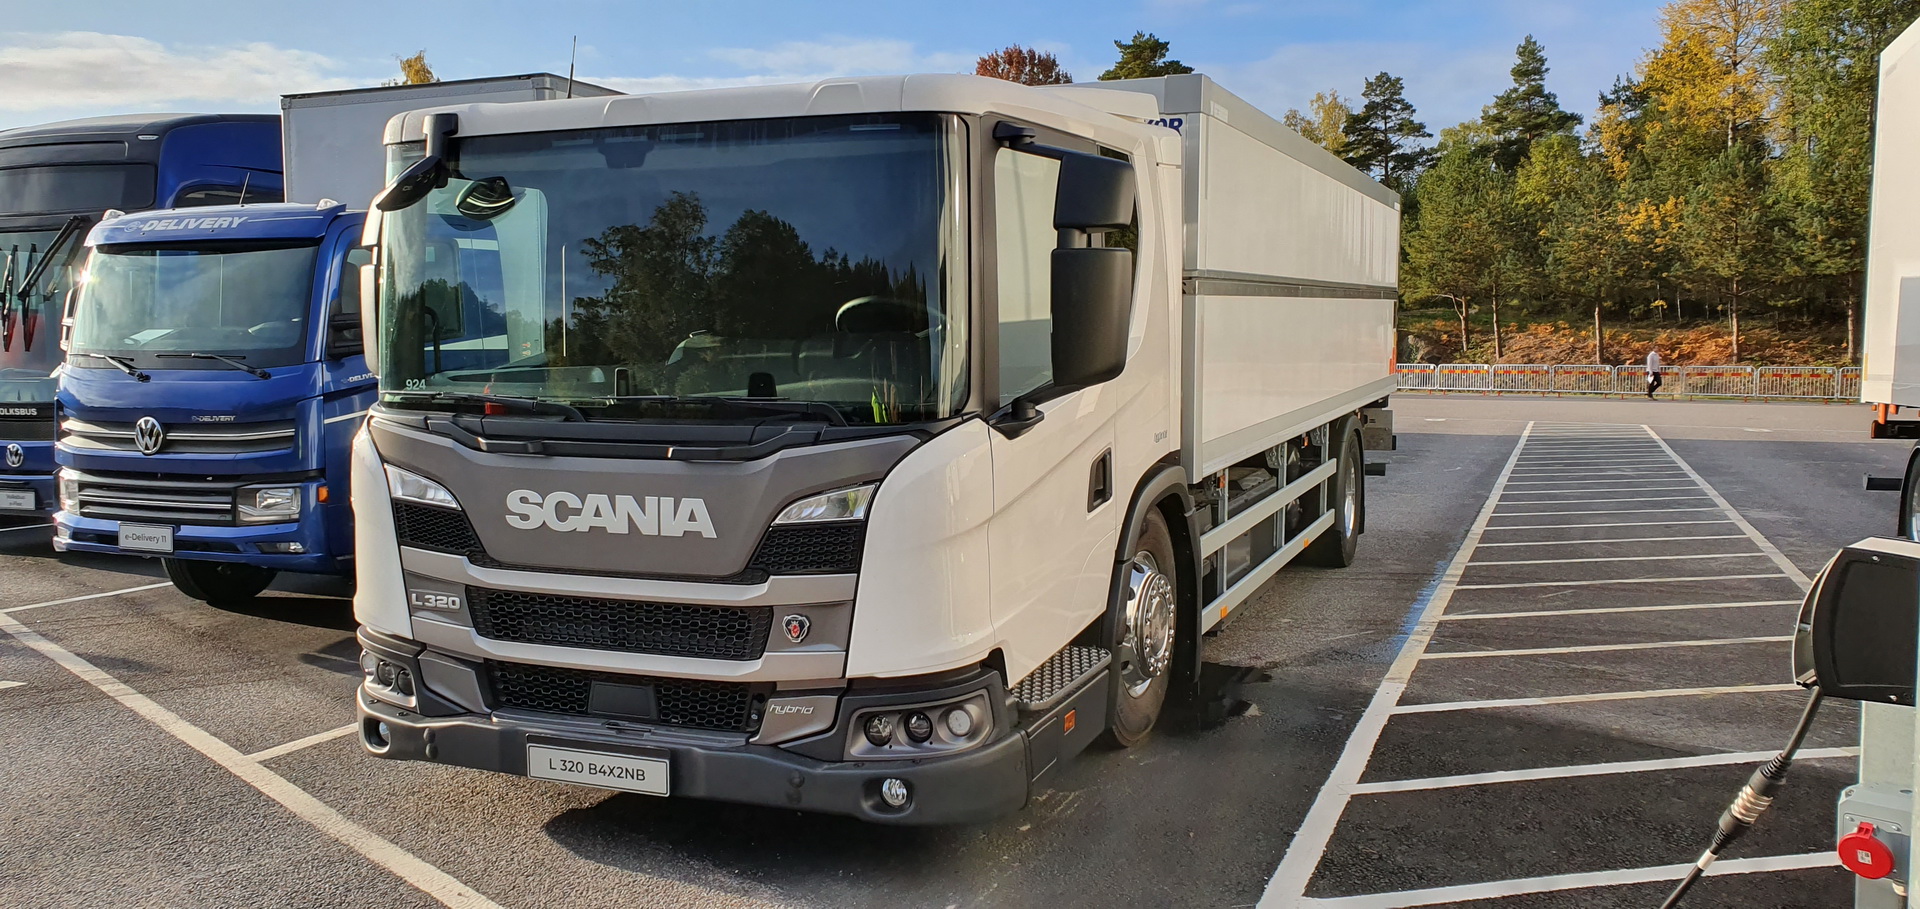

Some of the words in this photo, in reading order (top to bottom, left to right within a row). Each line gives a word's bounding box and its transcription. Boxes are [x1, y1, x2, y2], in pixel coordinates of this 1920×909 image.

[405, 379, 427, 390] 924
[505, 489, 718, 539] SCANIA
[125, 533, 160, 544] e-Delivery
[161, 535, 167, 543] 11
[769, 704, 815, 715] hybrid
[549, 758, 557, 770] L
[560, 759, 584, 774] 320
[588, 763, 646, 782] B4X2NB
